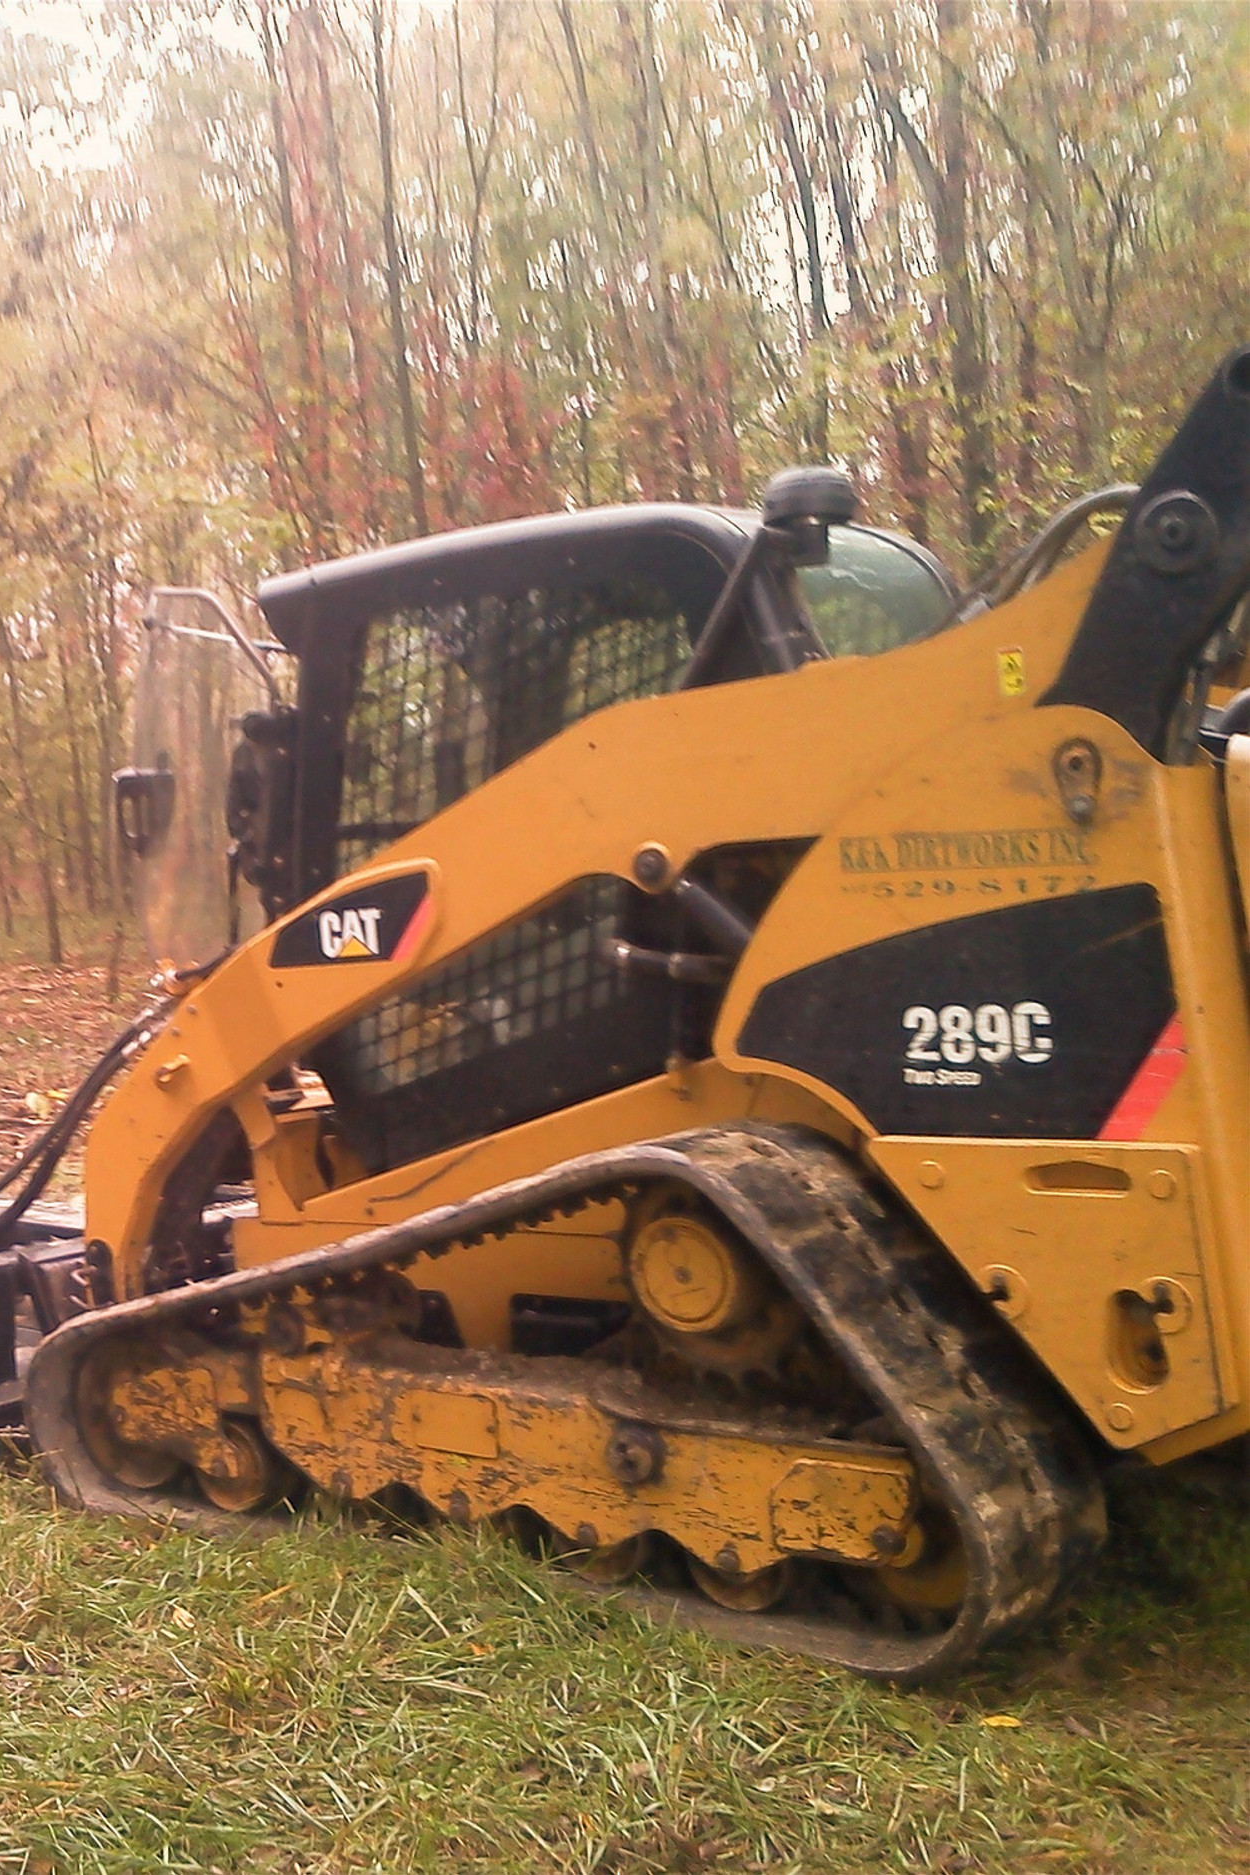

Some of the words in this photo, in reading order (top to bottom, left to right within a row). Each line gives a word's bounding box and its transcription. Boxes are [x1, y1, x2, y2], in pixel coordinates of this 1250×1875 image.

[894, 828, 1041, 871] DIRTWORKS
[319, 907, 382, 959] CAT
[902, 1001, 1053, 1063] 289C
